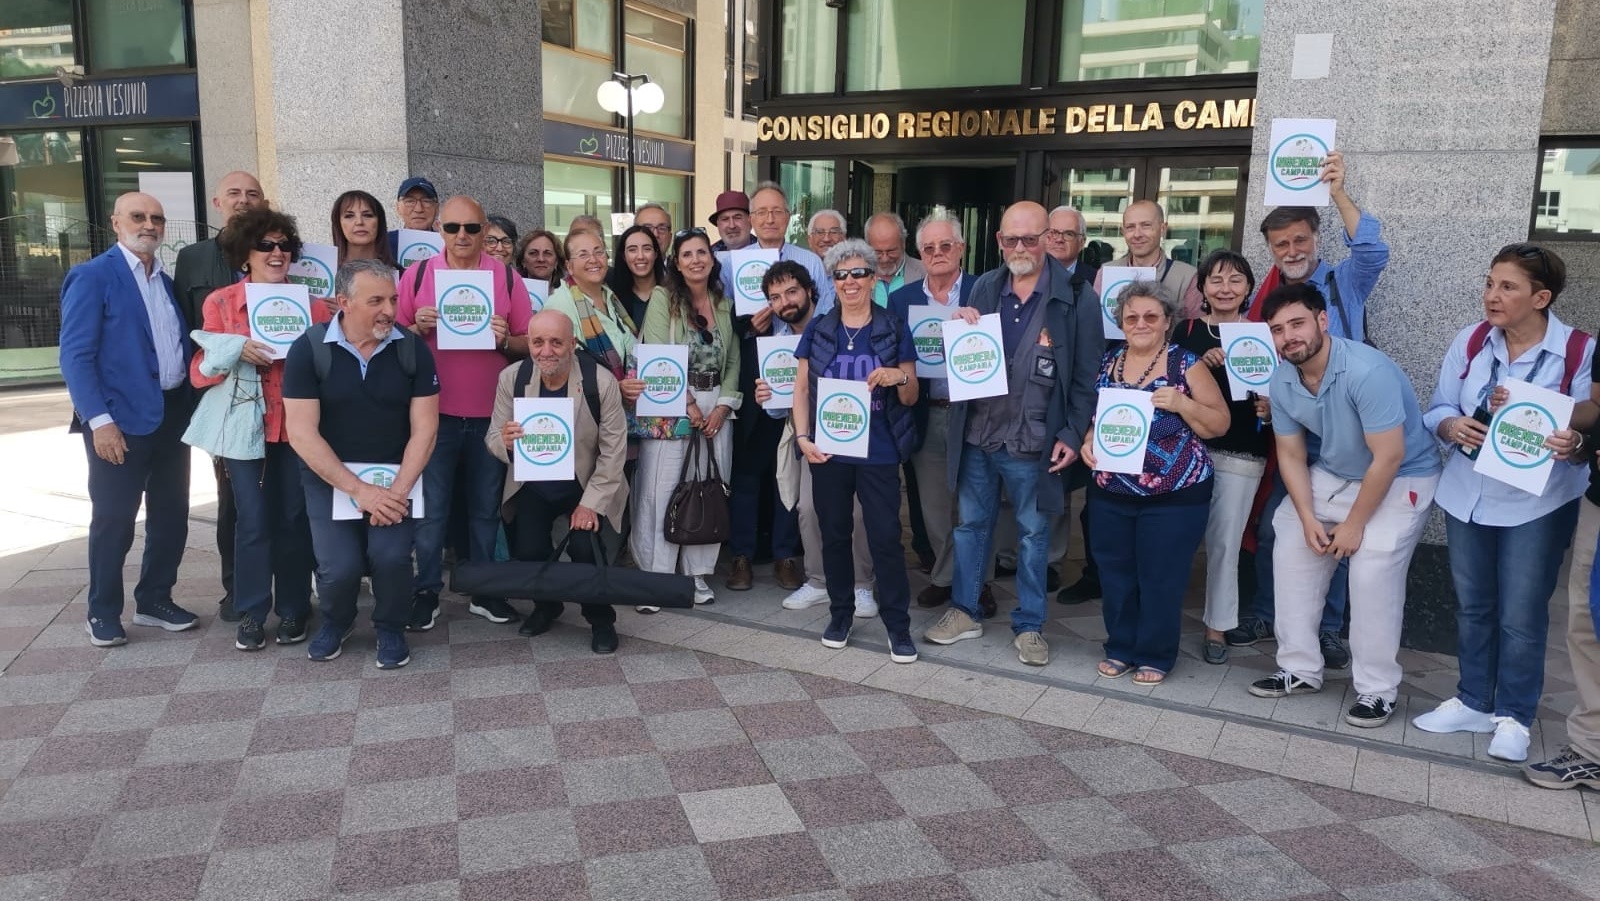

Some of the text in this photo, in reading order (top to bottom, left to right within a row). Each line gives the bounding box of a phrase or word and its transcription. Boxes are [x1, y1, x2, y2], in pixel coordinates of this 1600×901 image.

[63, 82, 148, 118] PIZZERIA VESUVIO
[757, 113, 890, 141] CONSIGLIO
[897, 107, 1056, 138] REGIONALE
[1065, 103, 1164, 134] DELLA
[637, 139, 665, 166] VESUVIO
[449, 315, 483, 323] CAMPANIA
[263, 324, 301, 333] CAMPANIA
[959, 360, 993, 373] CAMPANIA
[827, 420, 858, 431] CAMPANIA
[1498, 420, 1545, 449] RIGENER
[526, 444, 562, 453] CAMPANIA
